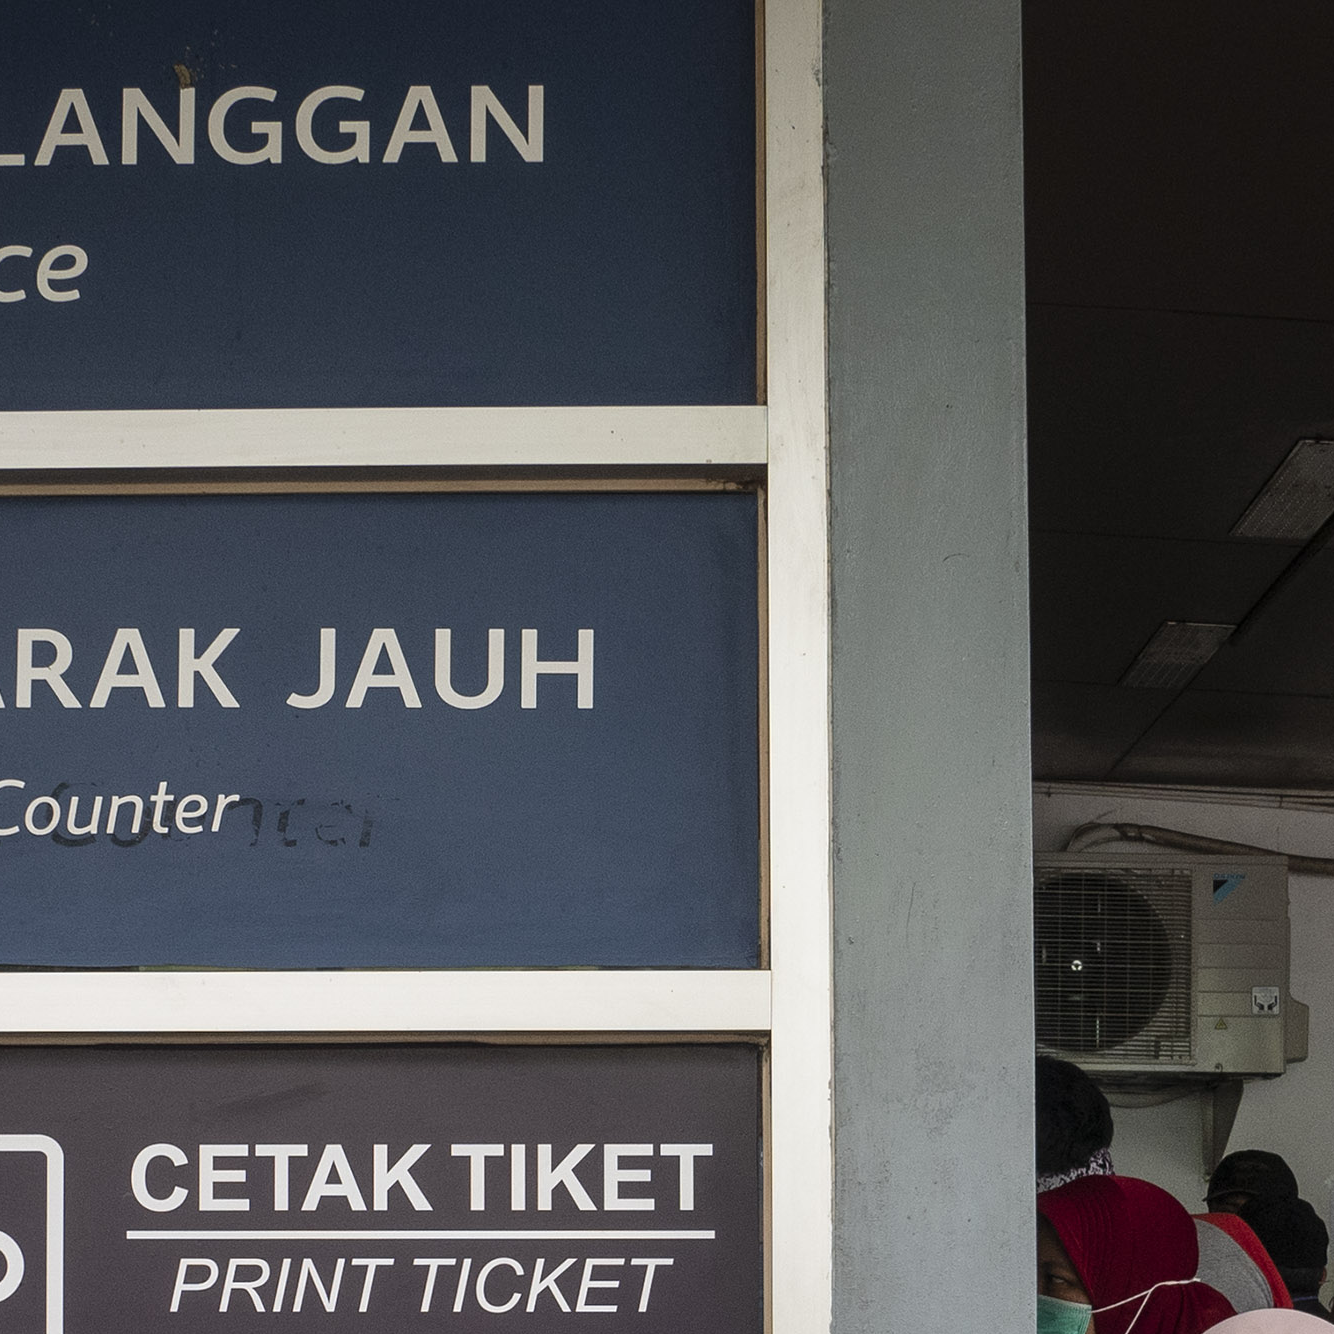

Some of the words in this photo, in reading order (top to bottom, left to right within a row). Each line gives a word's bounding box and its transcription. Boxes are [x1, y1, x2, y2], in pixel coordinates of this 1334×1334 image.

[285, 627, 595, 710] JAUH
[130, 1142, 434, 1213] CETAK
[450, 1143, 714, 1212] TIKET
[169, 1257, 395, 1313] PRINT
[412, 1256, 675, 1314] TICKET
